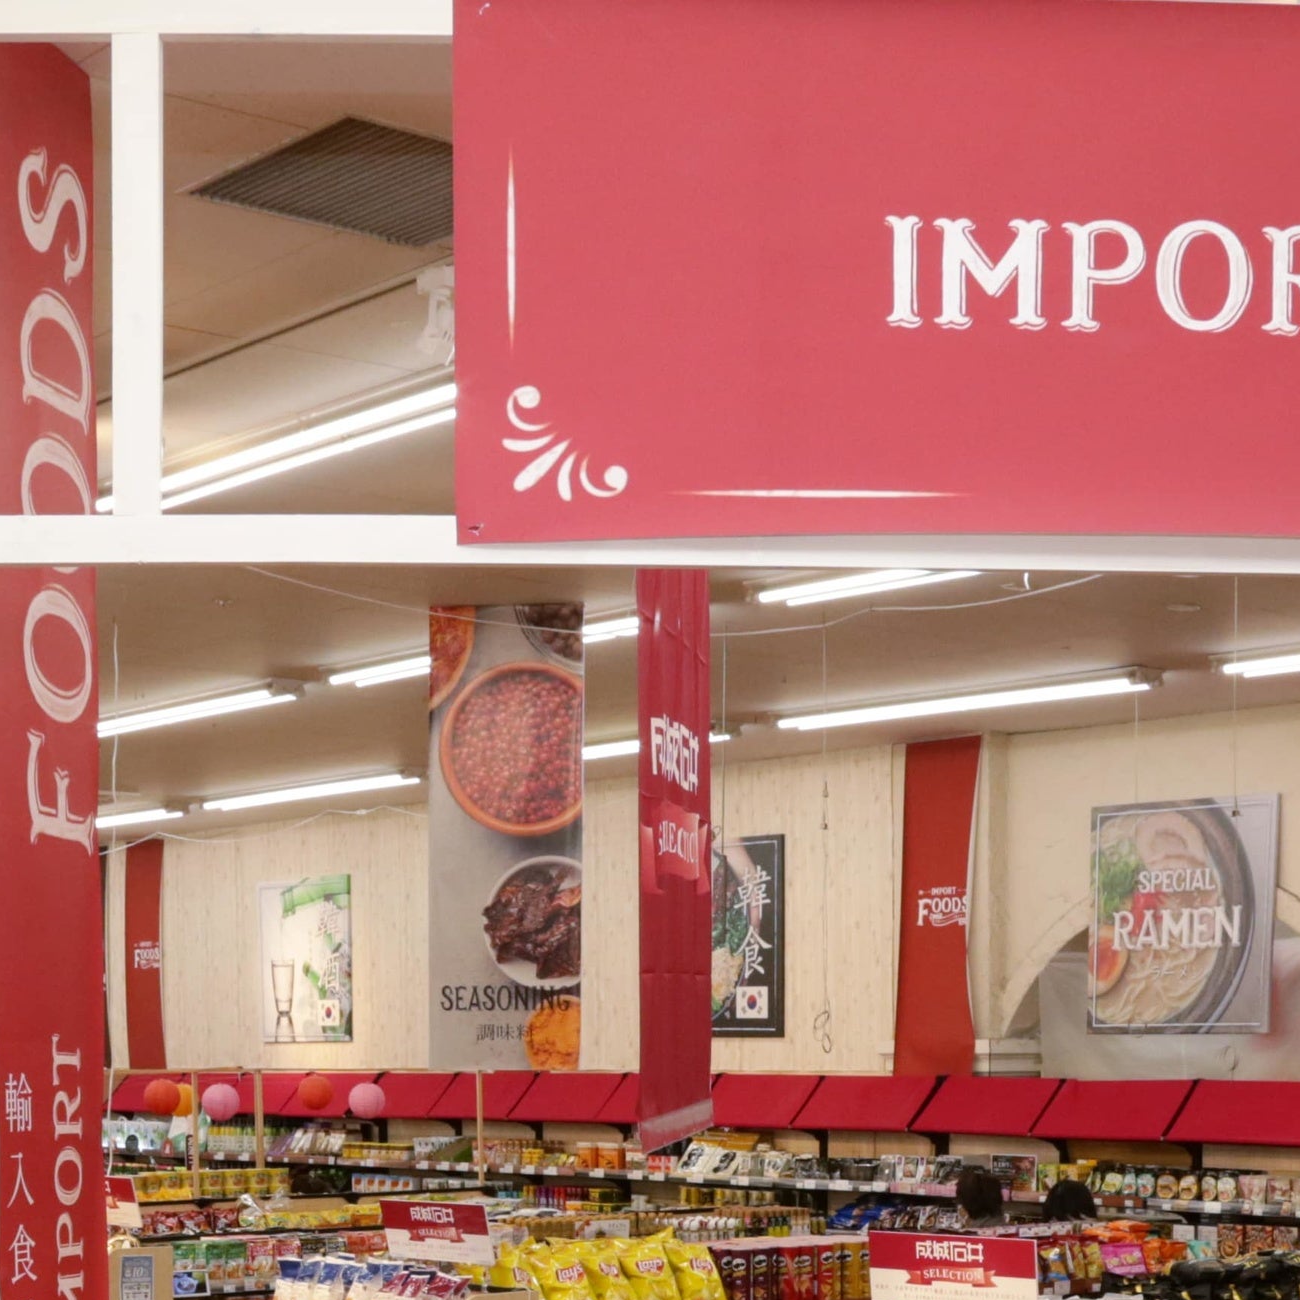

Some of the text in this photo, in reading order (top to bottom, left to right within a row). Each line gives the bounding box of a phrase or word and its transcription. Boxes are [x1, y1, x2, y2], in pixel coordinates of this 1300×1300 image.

[18, 146, 96, 857] FOODS
[931, 887, 957, 896] IMPORT
[1138, 867, 1216, 894] SPECIAL
[733, 865, 773, 979] 韓食
[1112, 904, 1243, 951] RAMEN
[441, 985, 571, 1012] SEASONING
[476, 1023, 537, 1042] 調味料
[410, 1205, 455, 1224] 成城石井
[915, 1240, 984, 1263] 成城石井
[923, 1268, 983, 1283] SELECTION
